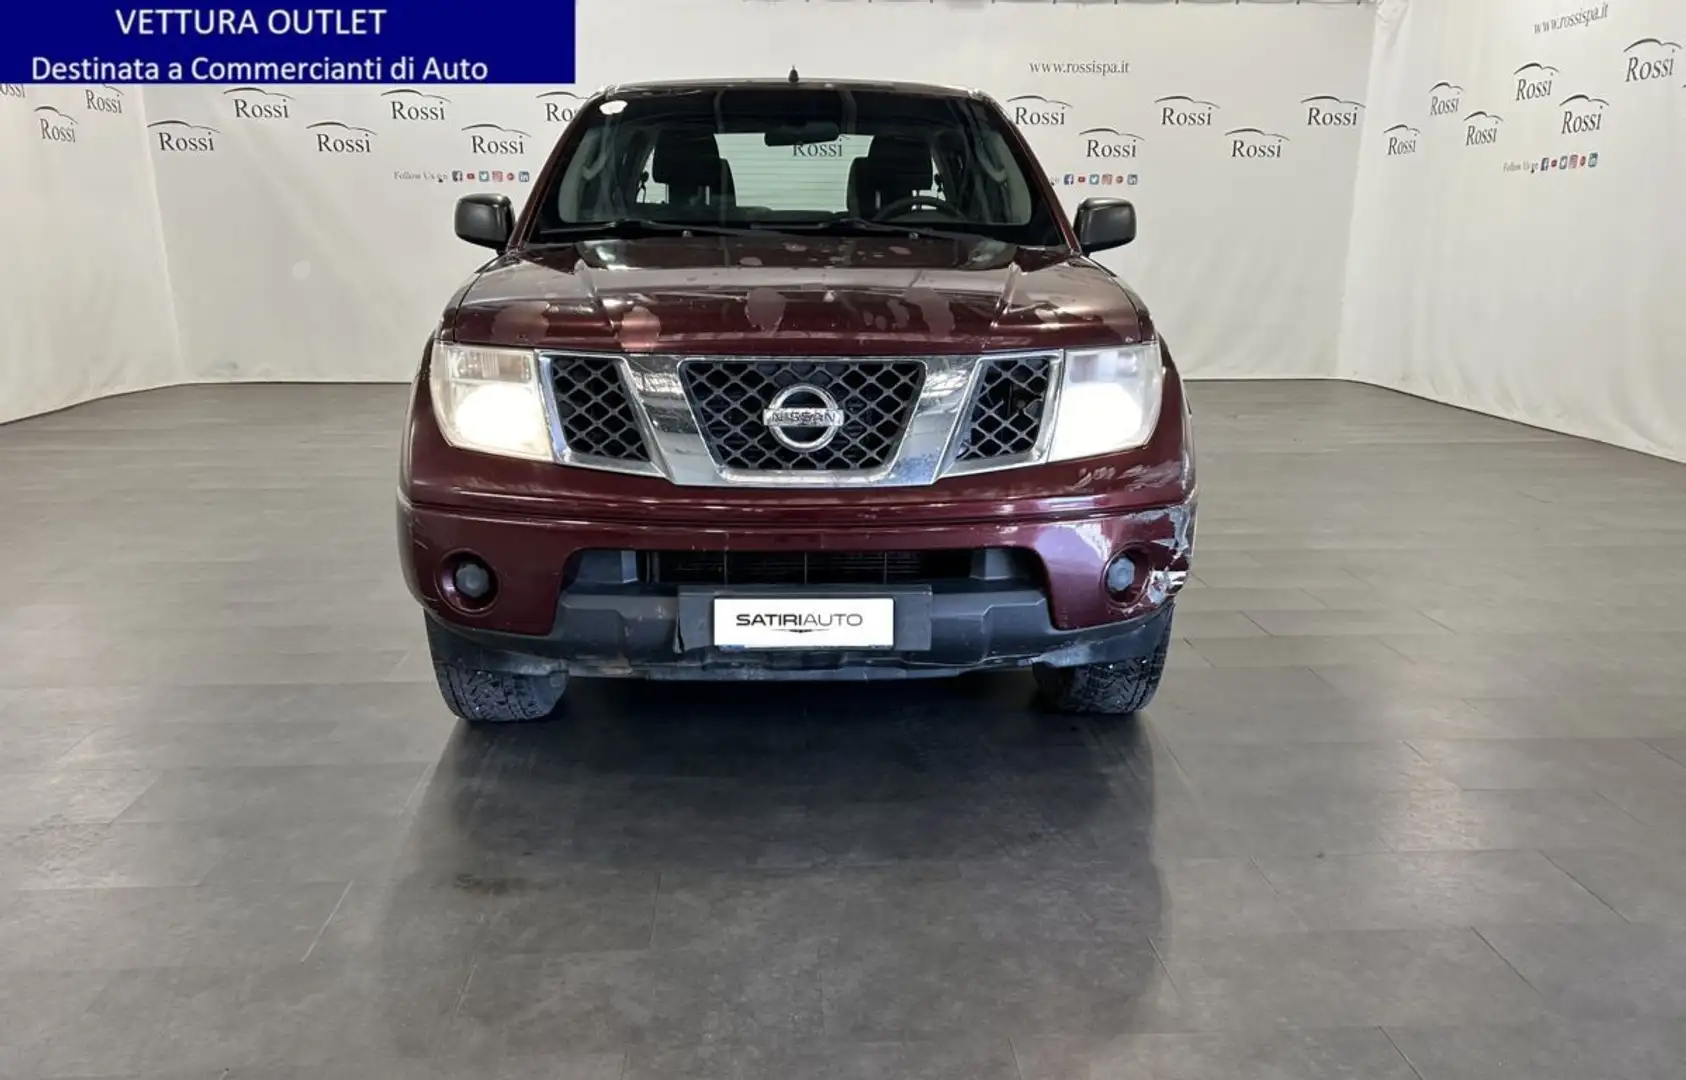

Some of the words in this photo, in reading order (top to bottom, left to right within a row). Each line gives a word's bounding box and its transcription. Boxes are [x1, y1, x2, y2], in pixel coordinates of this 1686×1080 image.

[1534, 3, 1609, 34] www.rossispa.it
[1029, 60, 1129, 77] www.rossispa.it
[1625, 48, 1676, 82] Rossi
[1516, 72, 1554, 101] Rossi
[85, 89, 122, 113] Rossi
[233, 97, 290, 119] Rossi
[390, 99, 446, 121] Rossi
[1430, 91, 1460, 116] Rossi
[1014, 106, 1066, 126] Rossi
[1161, 106, 1213, 126] Rossi
[1307, 106, 1358, 126] Rossi
[1561, 105, 1604, 134] Rossi
[40, 118, 76, 143] Rossi
[158, 130, 215, 152] Rossi
[1466, 120, 1500, 146] Rossi
[317, 131, 372, 153] Rossi
[471, 134, 525, 155] Rossi
[1086, 139, 1137, 158] Rossi
[1231, 139, 1282, 158] Rossi
[1387, 132, 1417, 155] Rossi
[771, 411, 836, 422] NISSAN
[735, 613, 864, 627] SATIRIAUTO
